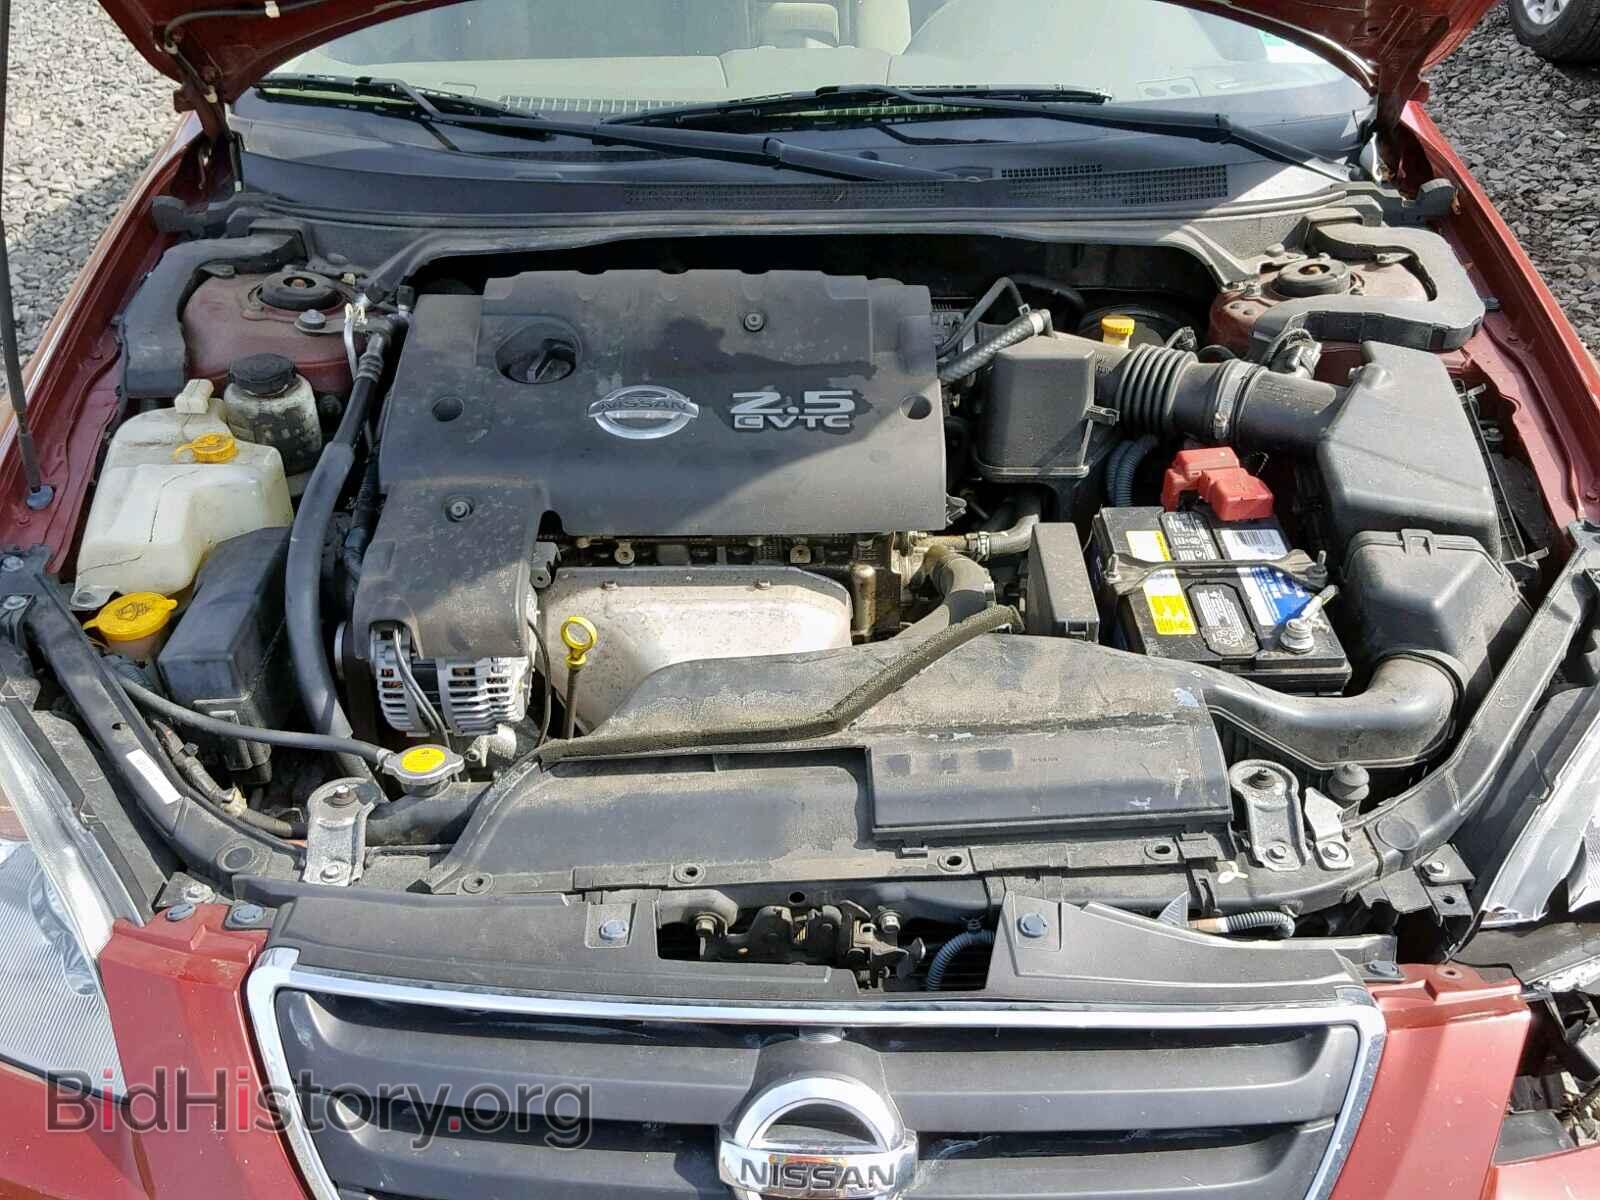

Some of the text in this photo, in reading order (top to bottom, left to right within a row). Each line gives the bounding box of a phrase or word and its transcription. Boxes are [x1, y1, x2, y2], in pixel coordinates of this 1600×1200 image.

[600, 399, 687, 410] NISSAN
[730, 390, 855, 414] 2.5
[740, 1157, 896, 1191] NISSAN
